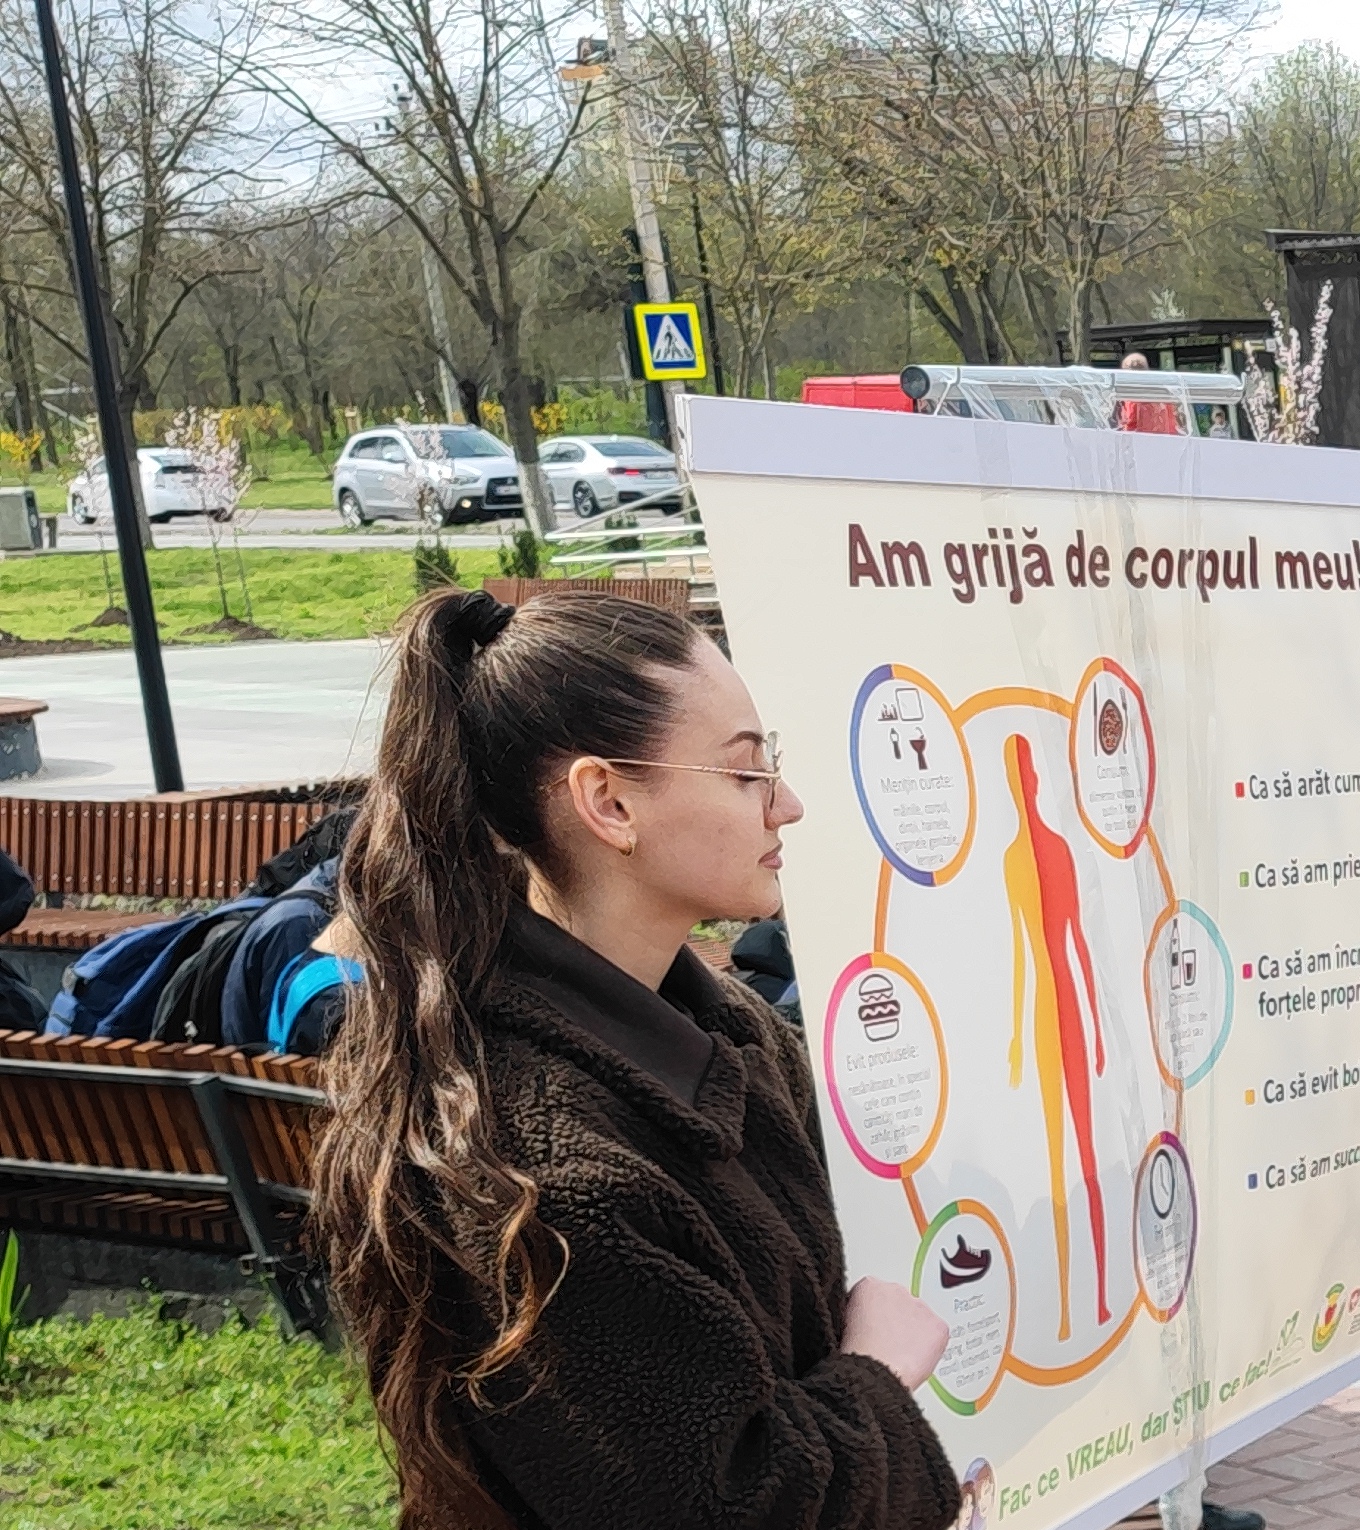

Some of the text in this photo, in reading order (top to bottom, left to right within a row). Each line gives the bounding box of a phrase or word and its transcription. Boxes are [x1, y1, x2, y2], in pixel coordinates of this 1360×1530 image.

[848, 523, 932, 588] Am
[944, 526, 1055, 605] grijă
[1066, 529, 1111, 589] de
[1124, 536, 1260, 604] corpul
[1250, 775, 1268, 799] Ca
[1273, 771, 1292, 798] să
[1298, 768, 1331, 797] arăt
[1255, 863, 1276, 888] Ca
[1281, 858, 1299, 886] să
[1304, 862, 1329, 883] am
[1258, 955, 1280, 980] Ca
[1285, 950, 1302, 977] să
[1307, 952, 1331, 973] am
[1258, 986, 1316, 1020] forțele
[1264, 1079, 1284, 1104] Ca
[1289, 1071, 1306, 1099] să
[1311, 1066, 1339, 1094] evit
[1266, 1165, 1285, 1189] Ca
[1290, 1155, 1306, 1184] să
[1310, 1155, 1330, 1178] am
[999, 1482, 1032, 1521] Fac
[1037, 1467, 1060, 1497] ce
[1066, 1422, 1135, 1482] VREAU,
[1141, 1411, 1169, 1444] dar
[1219, 1375, 1241, 1403] ce
